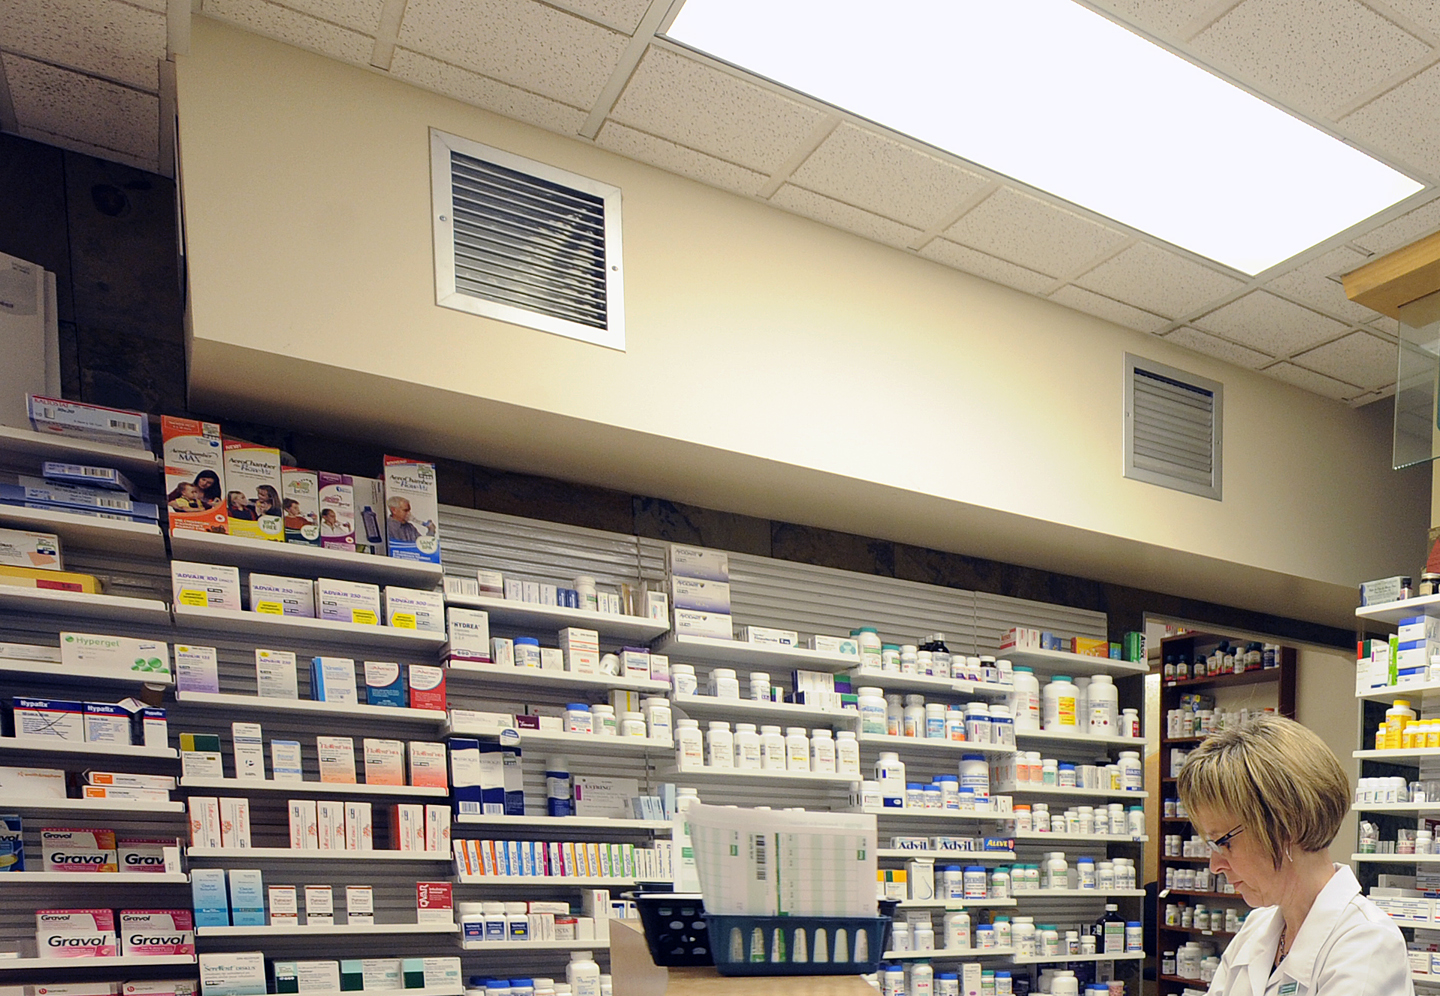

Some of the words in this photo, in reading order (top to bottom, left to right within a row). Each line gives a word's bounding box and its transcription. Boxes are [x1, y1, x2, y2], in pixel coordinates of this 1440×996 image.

[229, 457, 276, 470] AeroChamber
[389, 474, 433, 486] AeroChamber
[76, 636, 120, 647] Hypergel
[20, 700, 49, 708] Hypafix
[87, 705, 114, 713] Hypafix
[898, 839, 927, 851] Advil
[939, 840, 972, 851] Advil
[986, 839, 1008, 848] ALEVE
[51, 852, 108, 864] Gravol
[125, 853, 164, 865] Grav
[419, 883, 429, 908] QVAR
[48, 935, 106, 947] Gravol
[130, 935, 185, 946] Gravol
